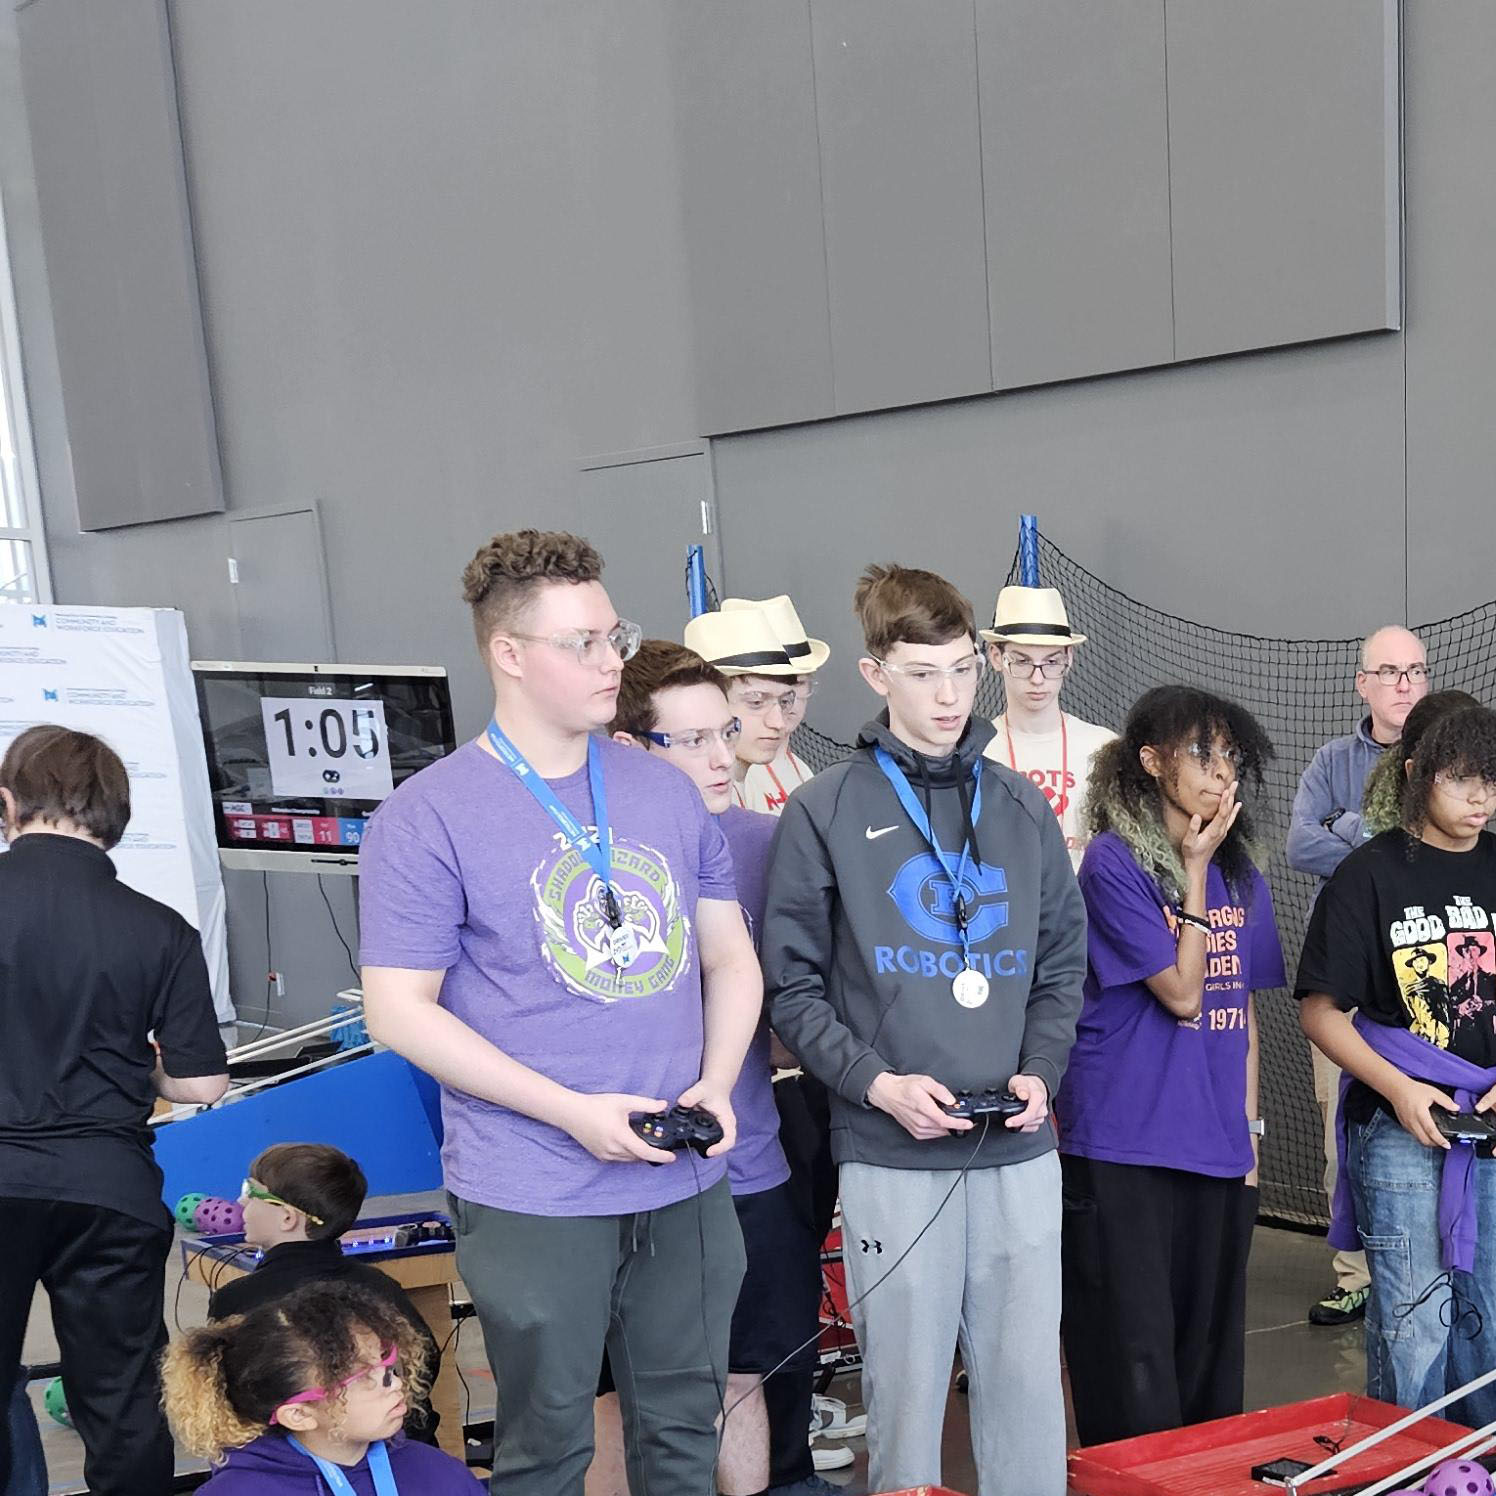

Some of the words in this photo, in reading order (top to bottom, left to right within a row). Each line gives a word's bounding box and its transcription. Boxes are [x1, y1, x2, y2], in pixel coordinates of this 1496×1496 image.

[326, 687, 333, 696] 2
[274, 708, 379, 760] 1:05
[1403, 905, 1426, 920] THE
[1445, 904, 1489, 930] BAD
[1389, 914, 1447, 948] GOOD
[874, 944, 1029, 980] ROBOTICS
[1205, 981, 1231, 992] GIRLS
[1207, 1007, 1248, 1031] 1971
